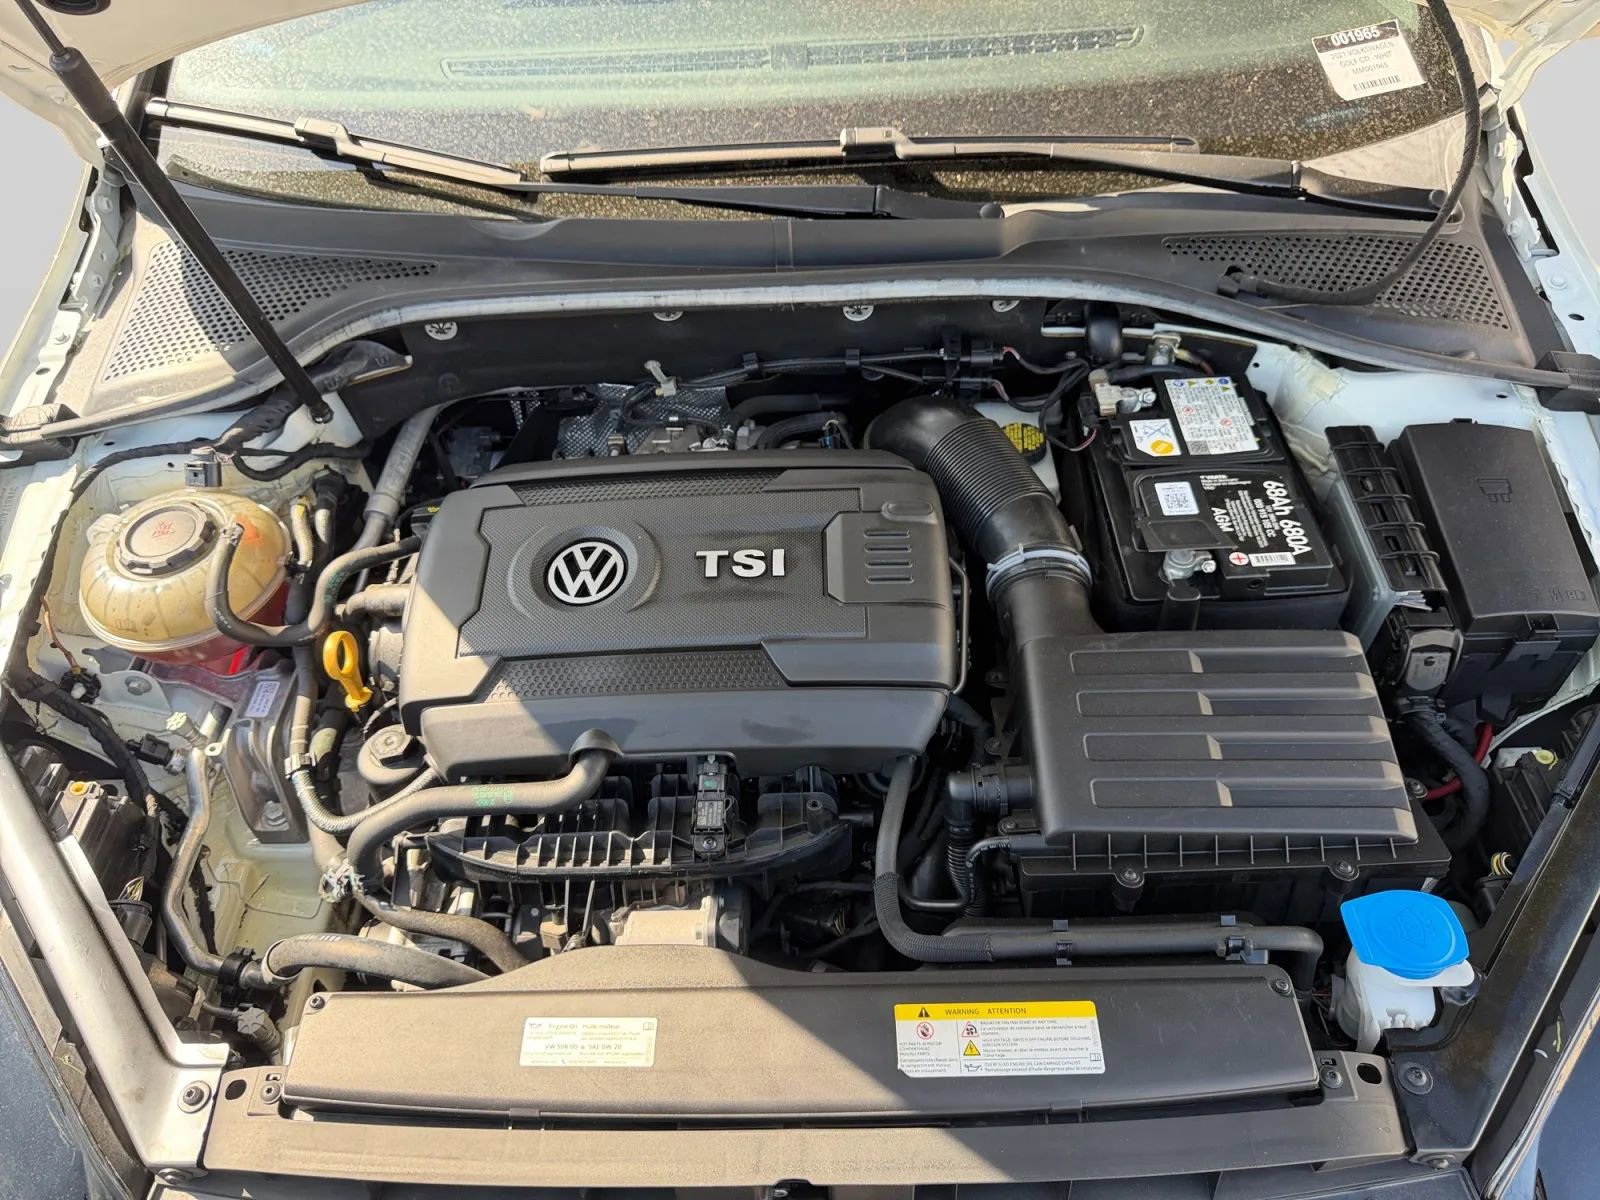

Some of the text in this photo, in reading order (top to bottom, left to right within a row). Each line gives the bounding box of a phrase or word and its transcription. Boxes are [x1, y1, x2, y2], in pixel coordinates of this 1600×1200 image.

[1330, 25, 1380, 46] 001965
[1347, 41, 1394, 56] VOLKSWAGEN
[1340, 58, 1357, 67] GOLF
[1211, 507, 1234, 532] AGM
[1263, 481, 1294, 515] 68Ah
[1280, 519, 1312, 555] 680A
[696, 549, 785, 578] TSI
